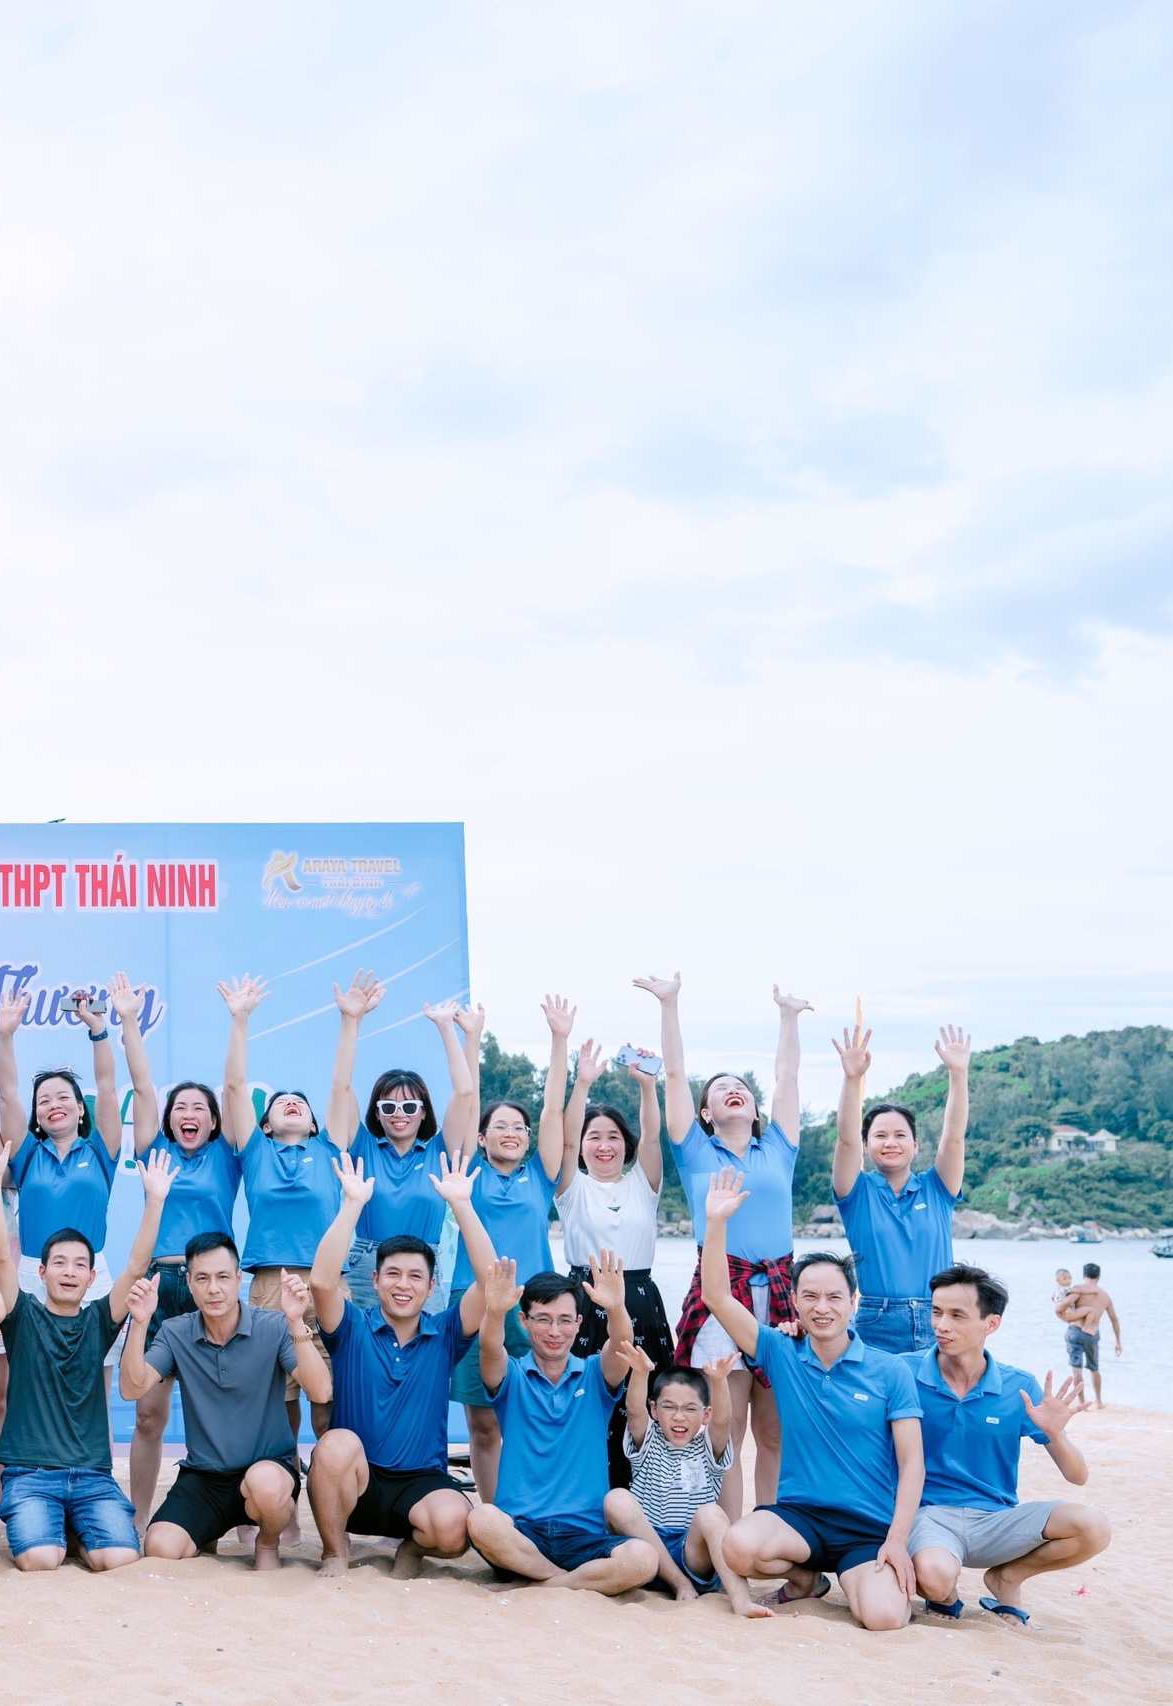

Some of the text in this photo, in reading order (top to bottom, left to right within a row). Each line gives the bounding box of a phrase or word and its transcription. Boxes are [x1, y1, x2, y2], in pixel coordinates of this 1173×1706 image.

[75, 855, 137, 907] THÁI
[147, 864, 216, 907] NINH
[303, 860, 401, 873] ARAYA TRAVEL
